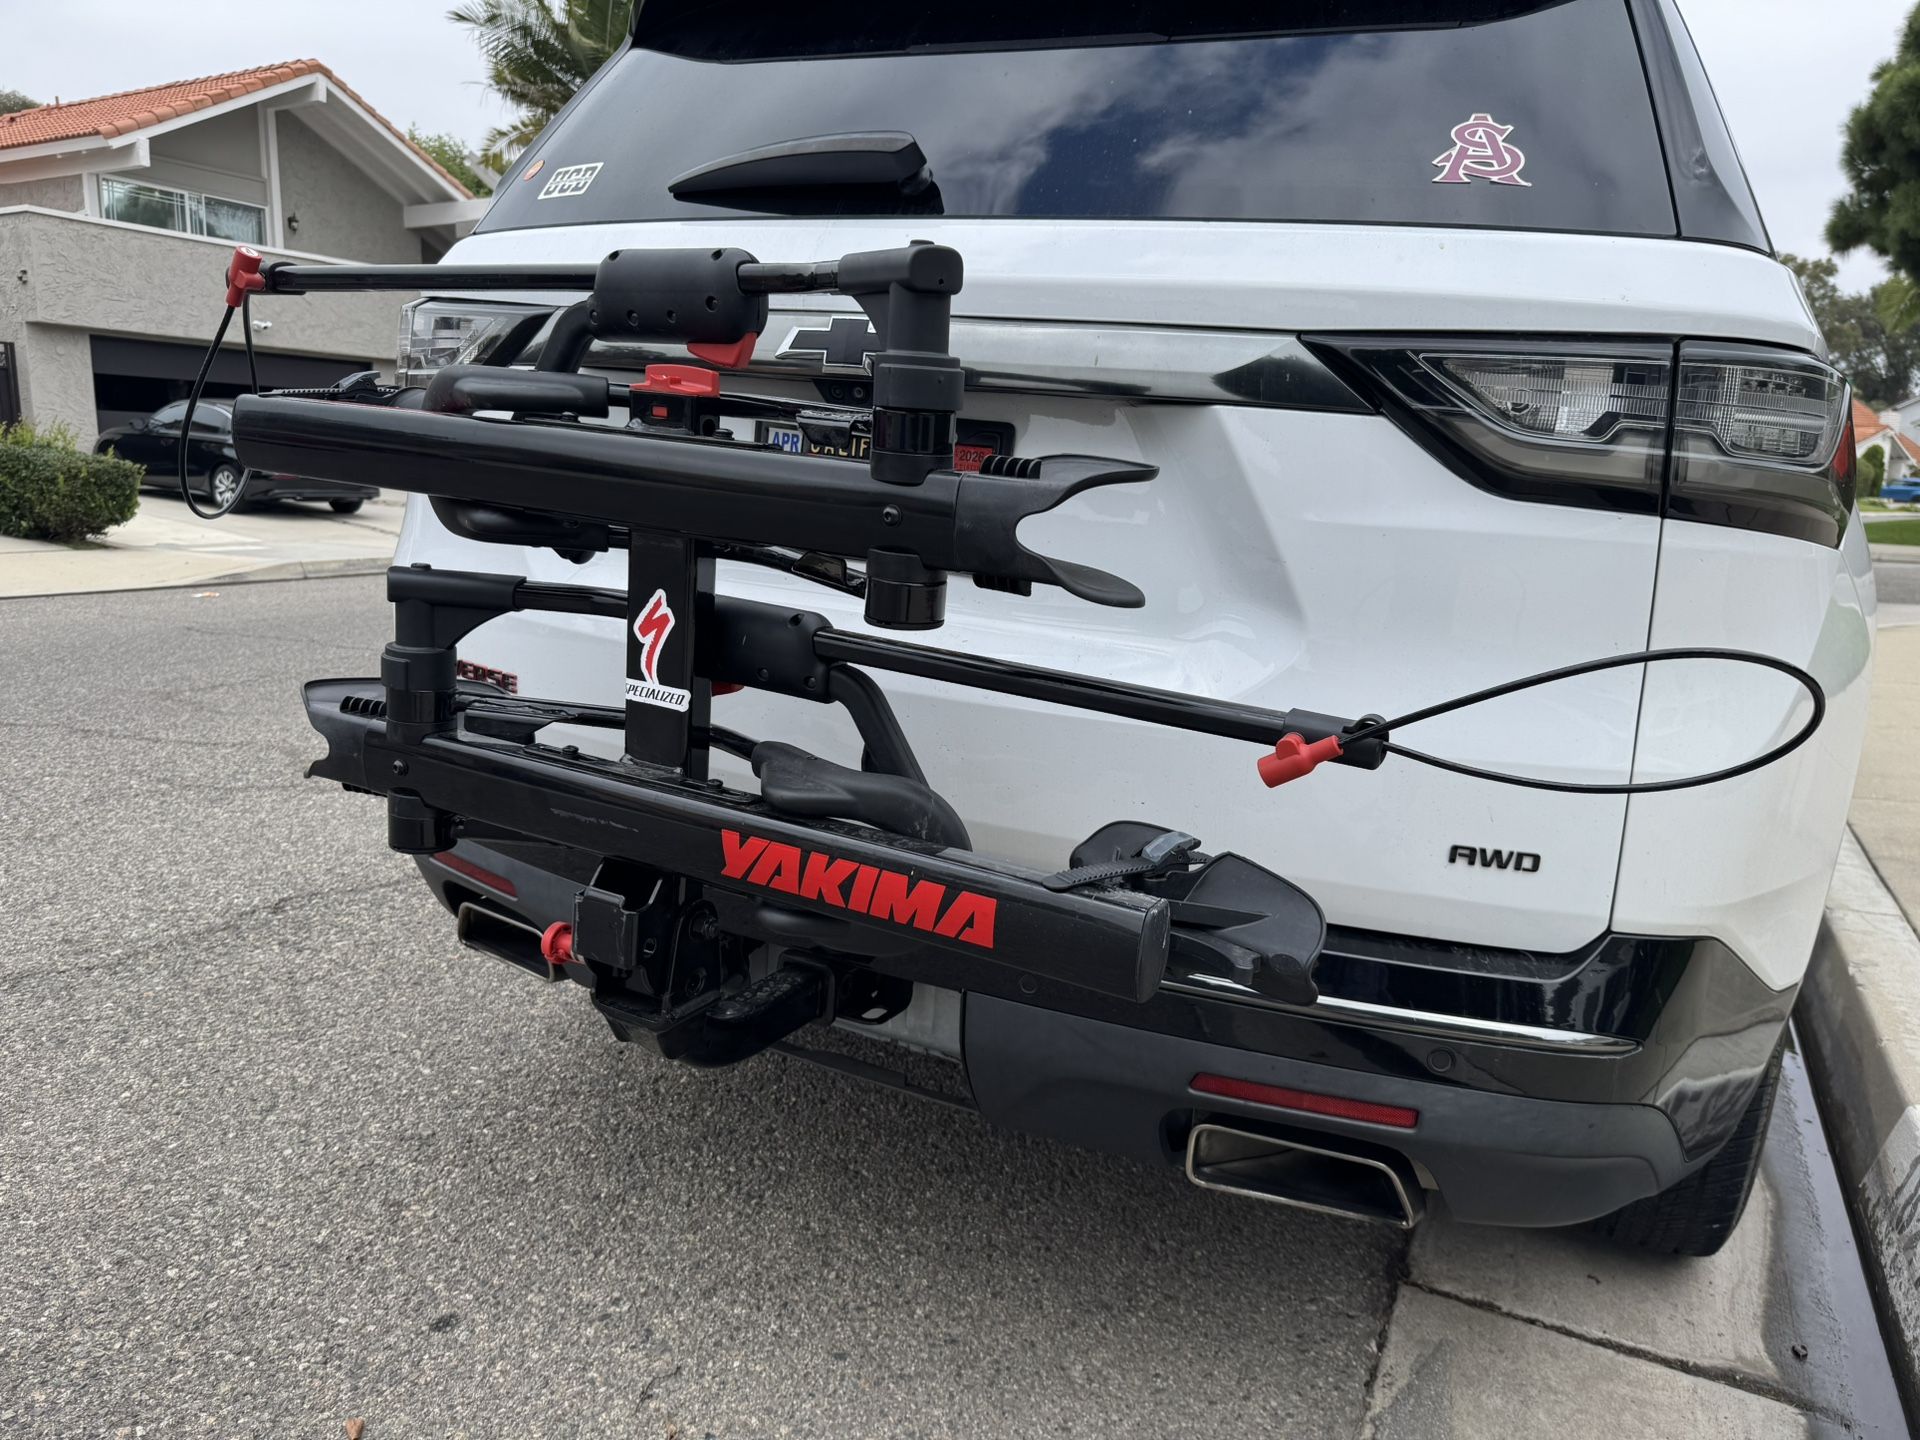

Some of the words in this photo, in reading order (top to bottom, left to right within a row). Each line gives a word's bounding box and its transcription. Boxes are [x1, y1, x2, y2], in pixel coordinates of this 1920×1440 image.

[773, 431, 800, 453] APR
[1448, 844, 1541, 873] AWD
[721, 829, 997, 949] YAKIMA
